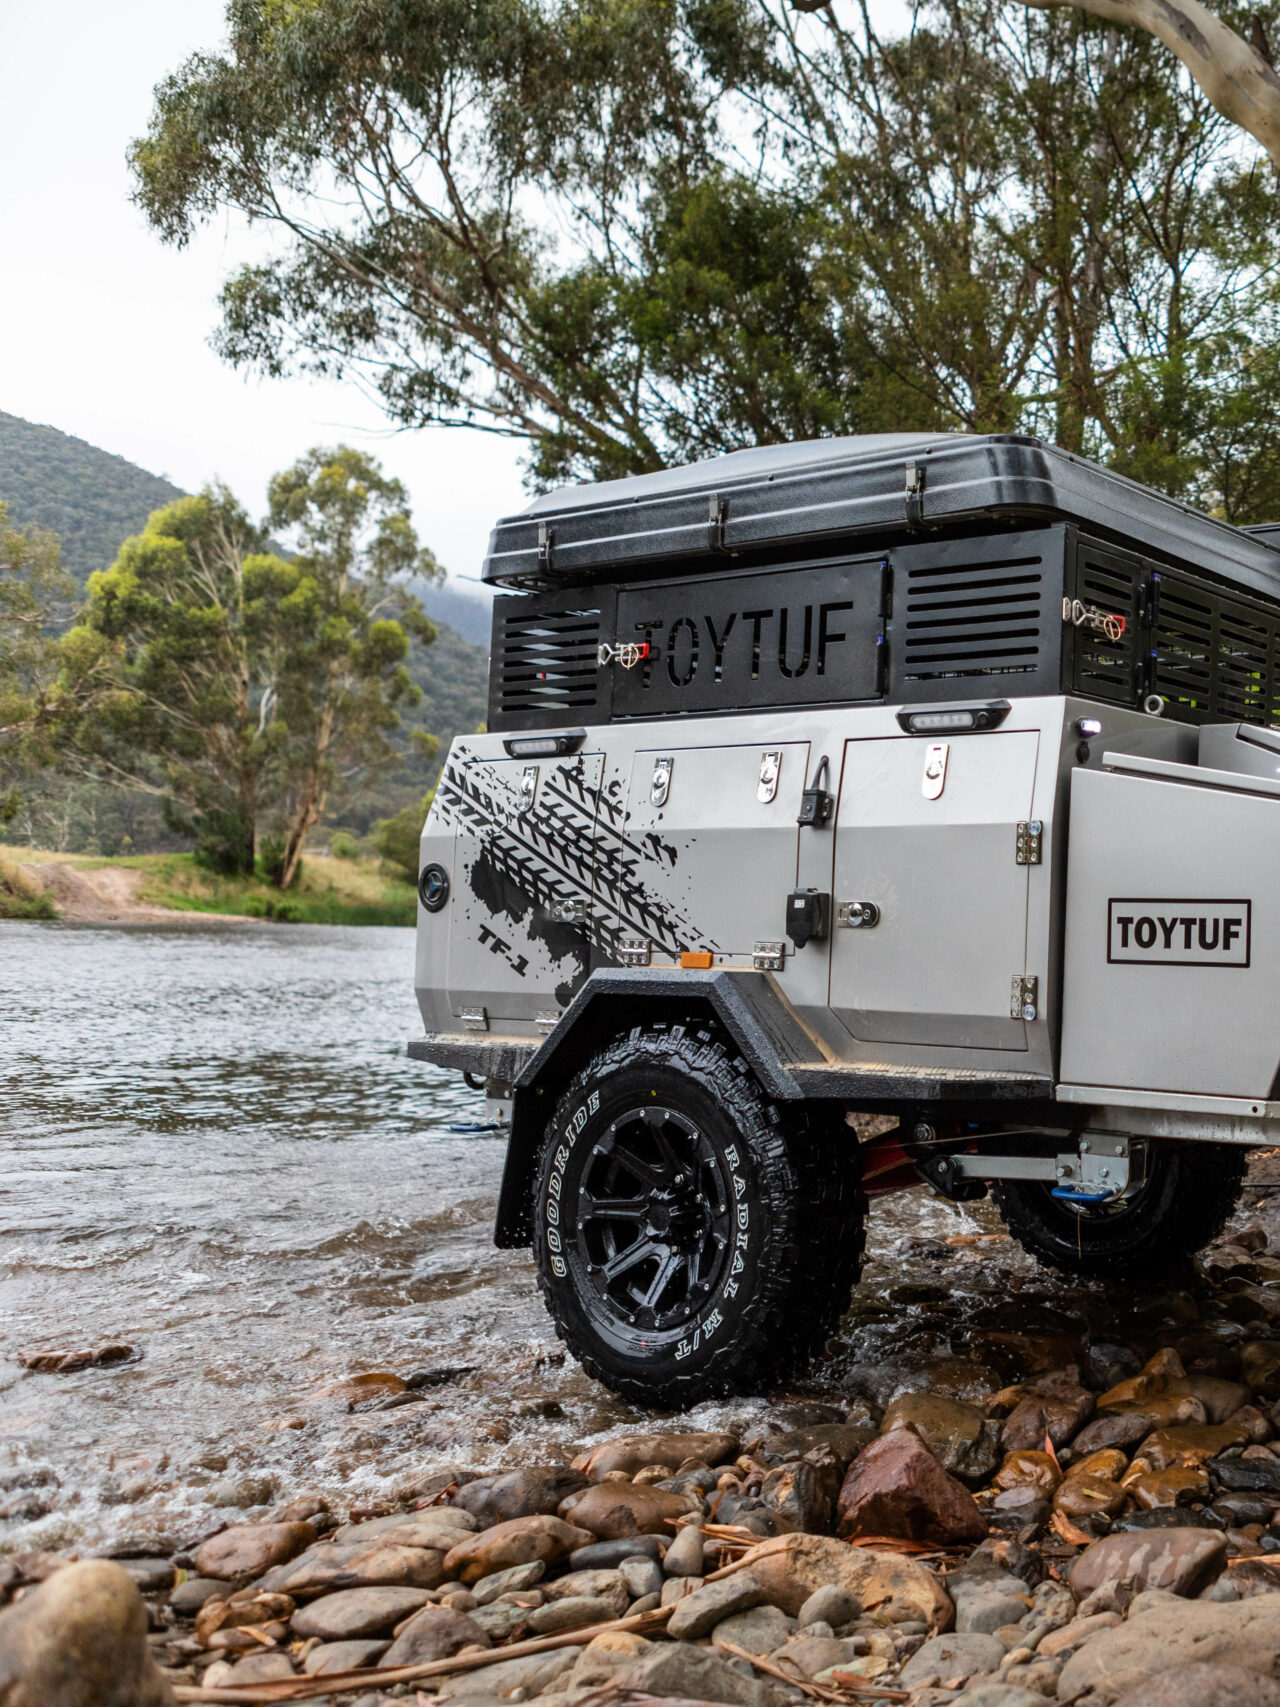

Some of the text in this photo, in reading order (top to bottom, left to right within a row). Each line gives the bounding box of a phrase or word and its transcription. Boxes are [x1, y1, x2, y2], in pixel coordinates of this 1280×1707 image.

[635, 601, 853, 689] TOYTUF
[477, 923, 529, 978] TF-1
[1117, 916, 1242, 950] TOYTUF
[547, 1090, 600, 1277] GOODRIDE
[674, 1144, 749, 1360] RADIAL M/T
